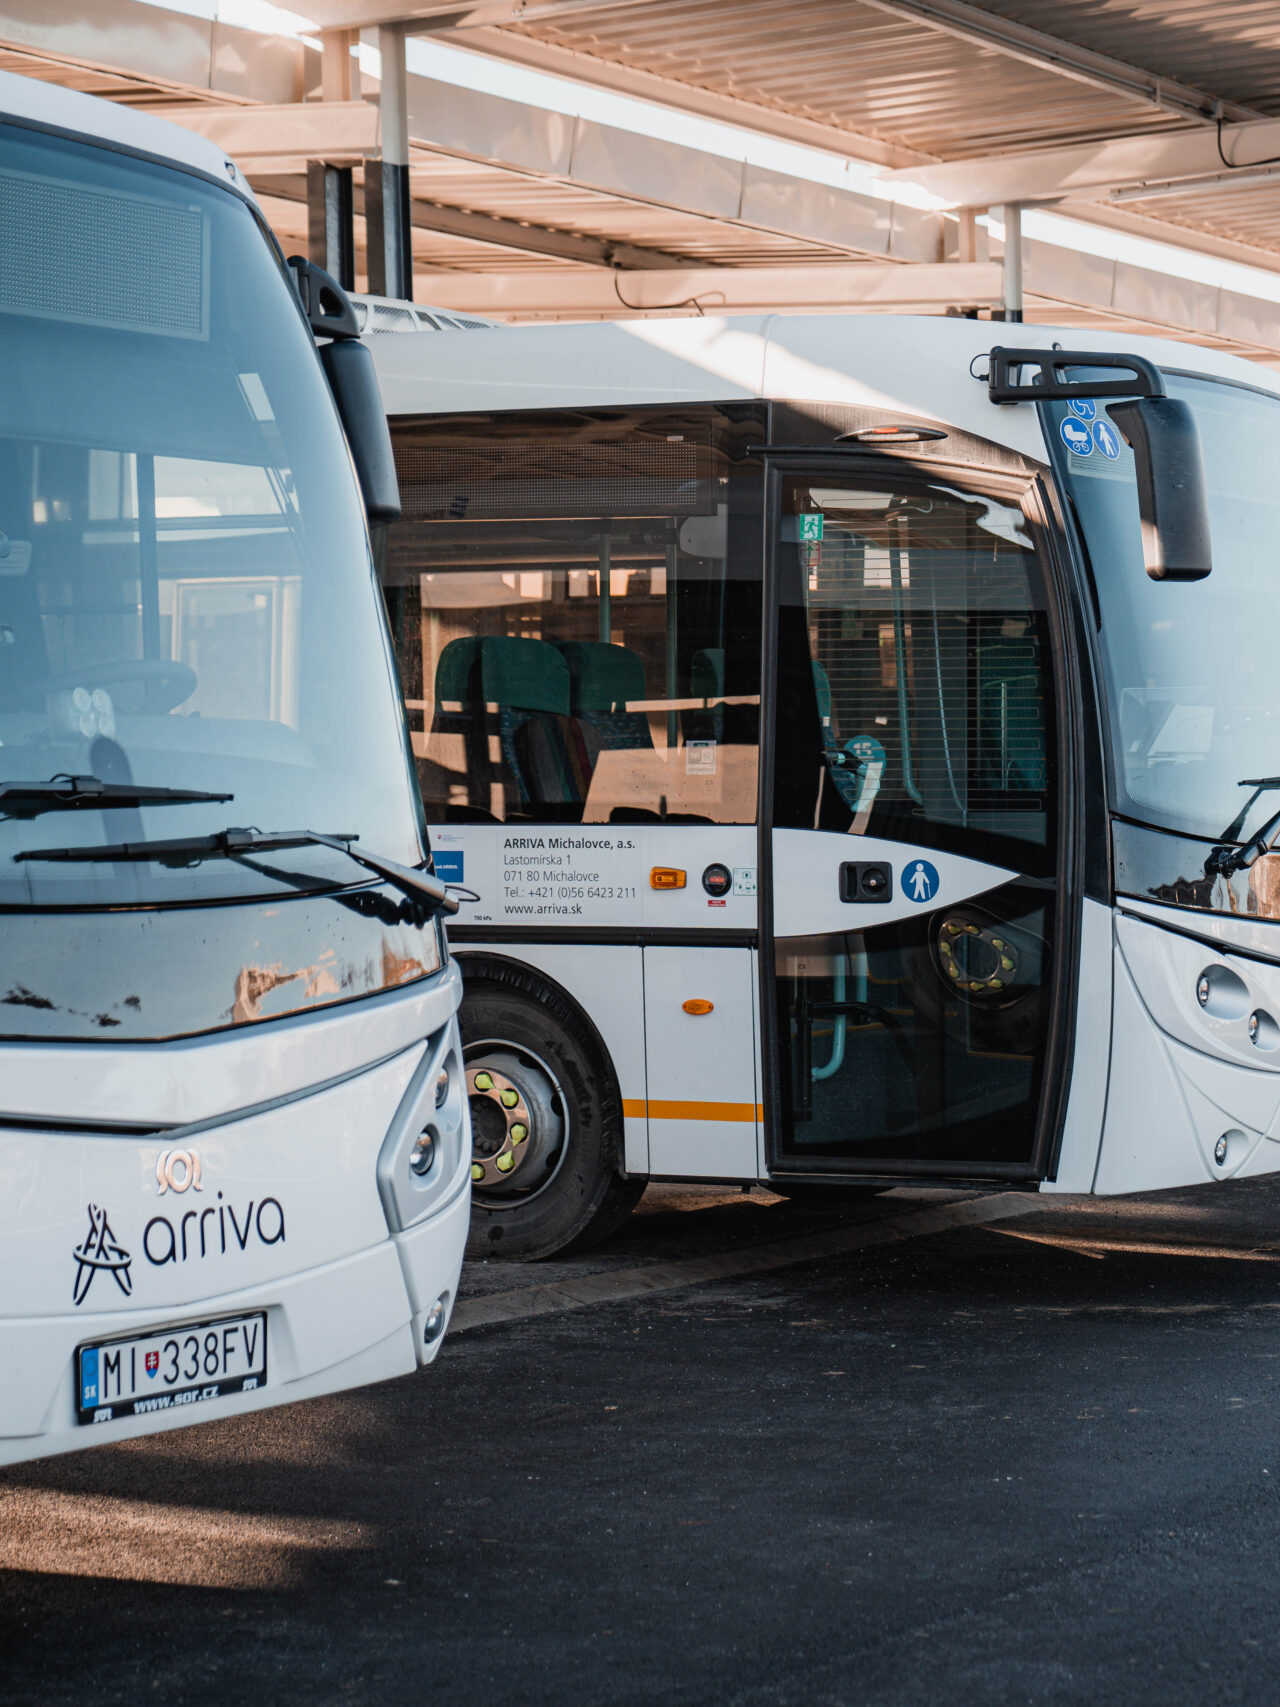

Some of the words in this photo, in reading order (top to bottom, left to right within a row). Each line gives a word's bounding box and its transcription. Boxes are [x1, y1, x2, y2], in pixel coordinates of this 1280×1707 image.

[504, 838, 545, 849] ARRIVA
[548, 837, 613, 850] Michalovce,
[617, 840, 635, 849] a.s.
[504, 854, 562, 866] Lastomírska
[566, 854, 571, 865] 1
[504, 870, 522, 882] 071
[526, 870, 540, 882] 80
[543, 869, 599, 882] Michalovce
[504, 886, 525, 898] Tel.:
[528, 887, 553, 898] +421
[557, 886, 584, 900] (0)56
[587, 887, 613, 899] 6423
[617, 887, 636, 899] 211
[504, 903, 583, 915] www.arriva.sk
[143, 1190, 286, 1266] arriva
[104, 1346, 136, 1399] MI
[163, 1322, 258, 1385] 338FV
[85, 1385, 97, 1399] SK
[133, 1386, 219, 1415] www.sor.cz
